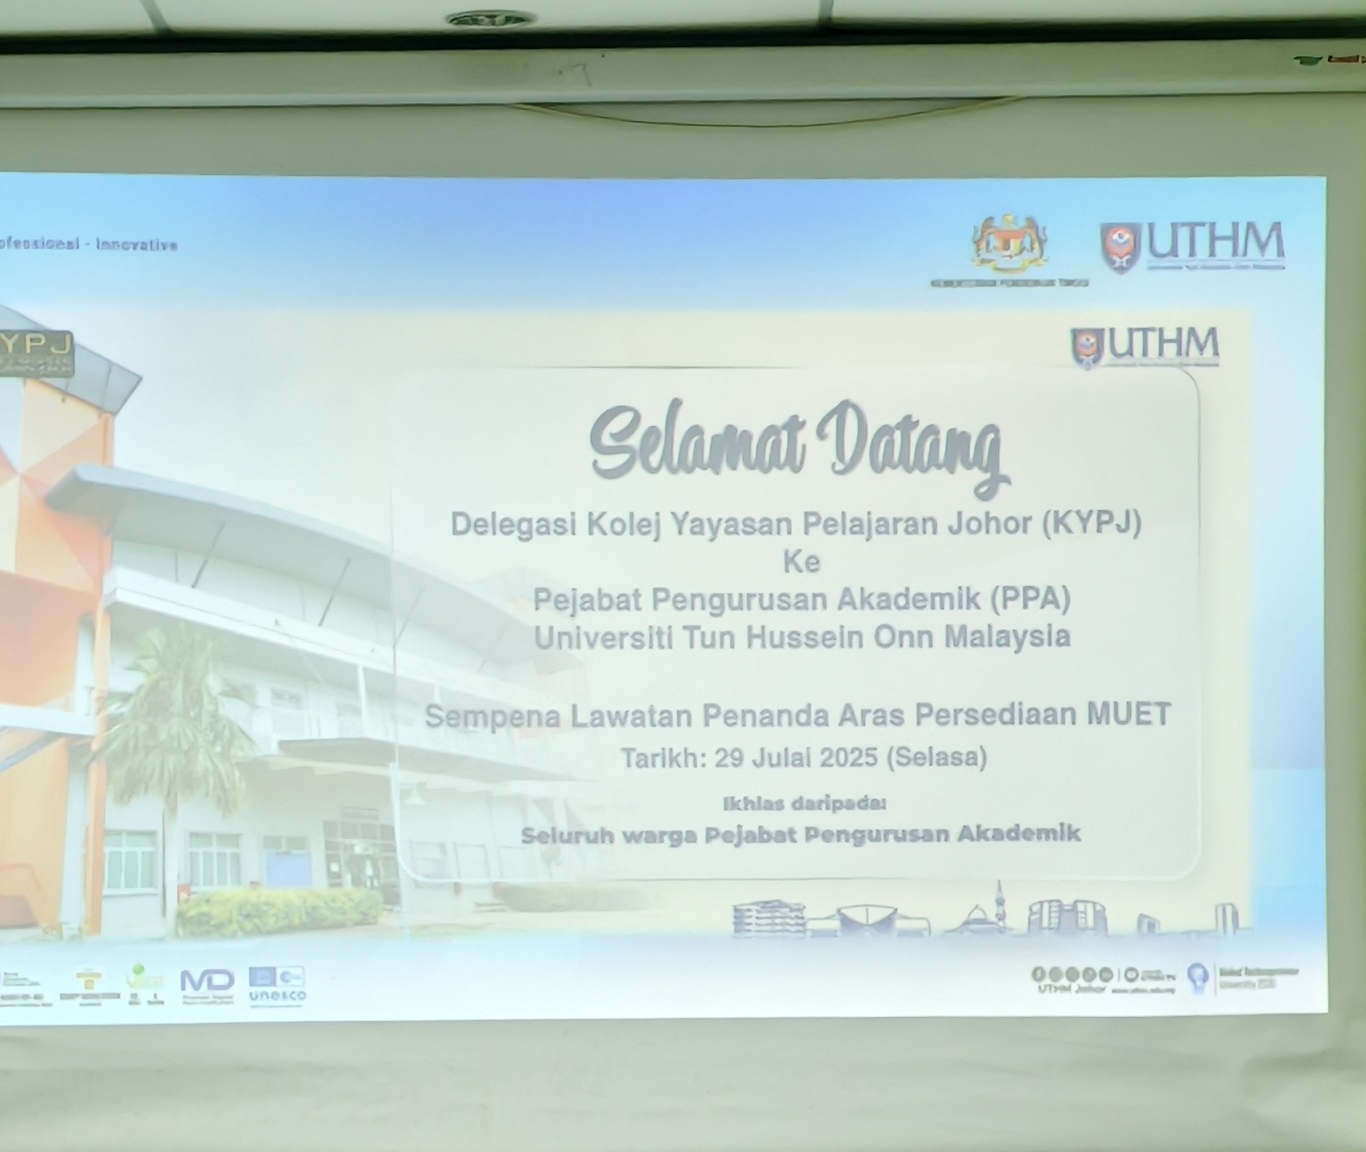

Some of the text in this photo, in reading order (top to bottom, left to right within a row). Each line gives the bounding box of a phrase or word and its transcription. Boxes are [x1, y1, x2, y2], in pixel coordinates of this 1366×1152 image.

[1148, 221, 1286, 258] UTHM
[1109, 326, 1220, 357] UTHM
[590, 397, 1012, 502] Selamat Datang
[452, 509, 1142, 542] Delegasi Kolej Yayasan Pelajaran Johor (KYPJ)
[784, 549, 821, 574] Ke
[534, 585, 1071, 618] Pejabat Pengurusan Akademik (PPA)
[535, 623, 1072, 654] Universiti Tun Hussein Onn Malaysia
[425, 701, 1173, 734] Sempena Lawatan Penanda Aras Persediaan MUET
[620, 745, 988, 772] Tarikh: 29 Julai 2025 (Selasa)
[723, 794, 887, 815] Ikhlas daripada:
[521, 821, 1082, 849] Seluruh warga Pejabat Pengurusan Akademik
